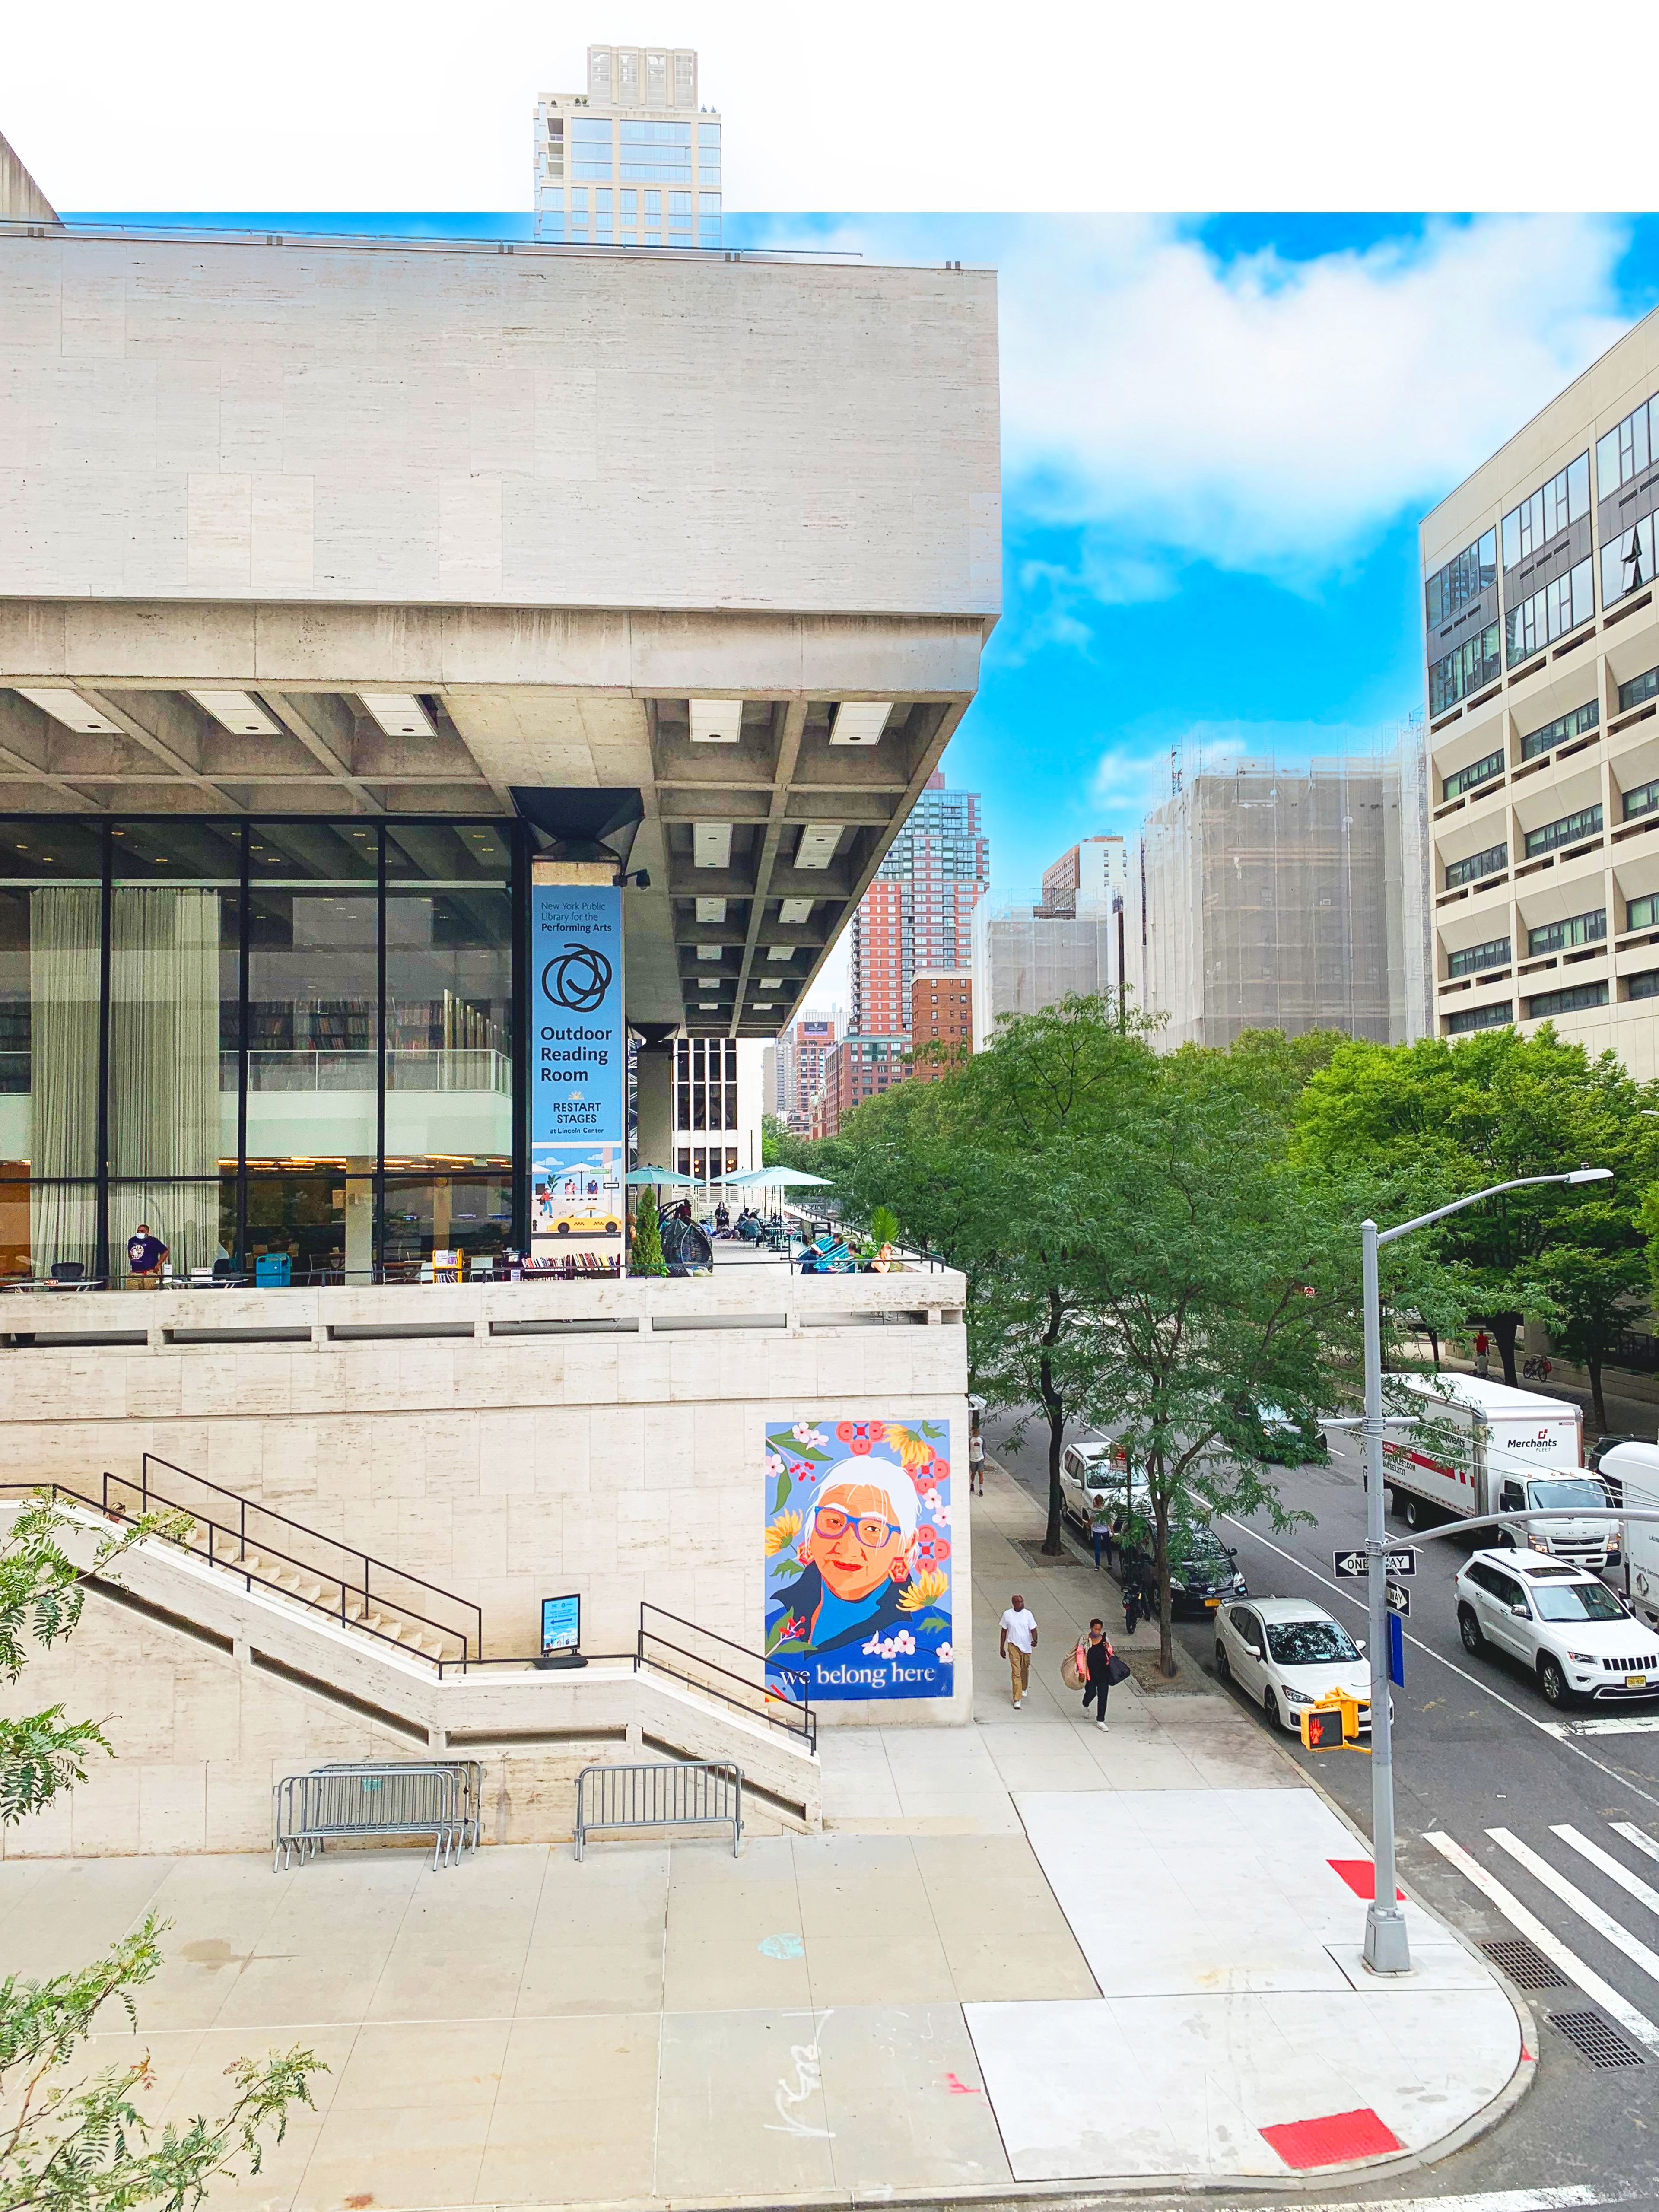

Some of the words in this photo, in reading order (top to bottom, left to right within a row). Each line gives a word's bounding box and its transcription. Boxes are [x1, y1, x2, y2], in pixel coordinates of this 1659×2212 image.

[541, 902, 559, 910] New
[562, 902, 579, 910] York
[582, 902, 605, 910] Public
[541, 912, 569, 923] Library
[571, 912, 582, 921] for
[585, 912, 598, 921] the
[541, 923, 591, 934] Performing
[540, 1026, 612, 1040] Outdoor
[541, 1047, 608, 1065] Reading
[541, 1068, 588, 1081] Room
[553, 1103, 601, 1112] RESTART
[557, 1114, 597, 1123] STAGES
[1507, 1438, 1557, 1448] Merchants
[1347, 1559, 1369, 1569] ONE
[1389, 1589, 1403, 1604] WAY
[779, 1670, 810, 1685] we
[816, 1664, 886, 1688] belong
[891, 1662, 936, 1682] here
